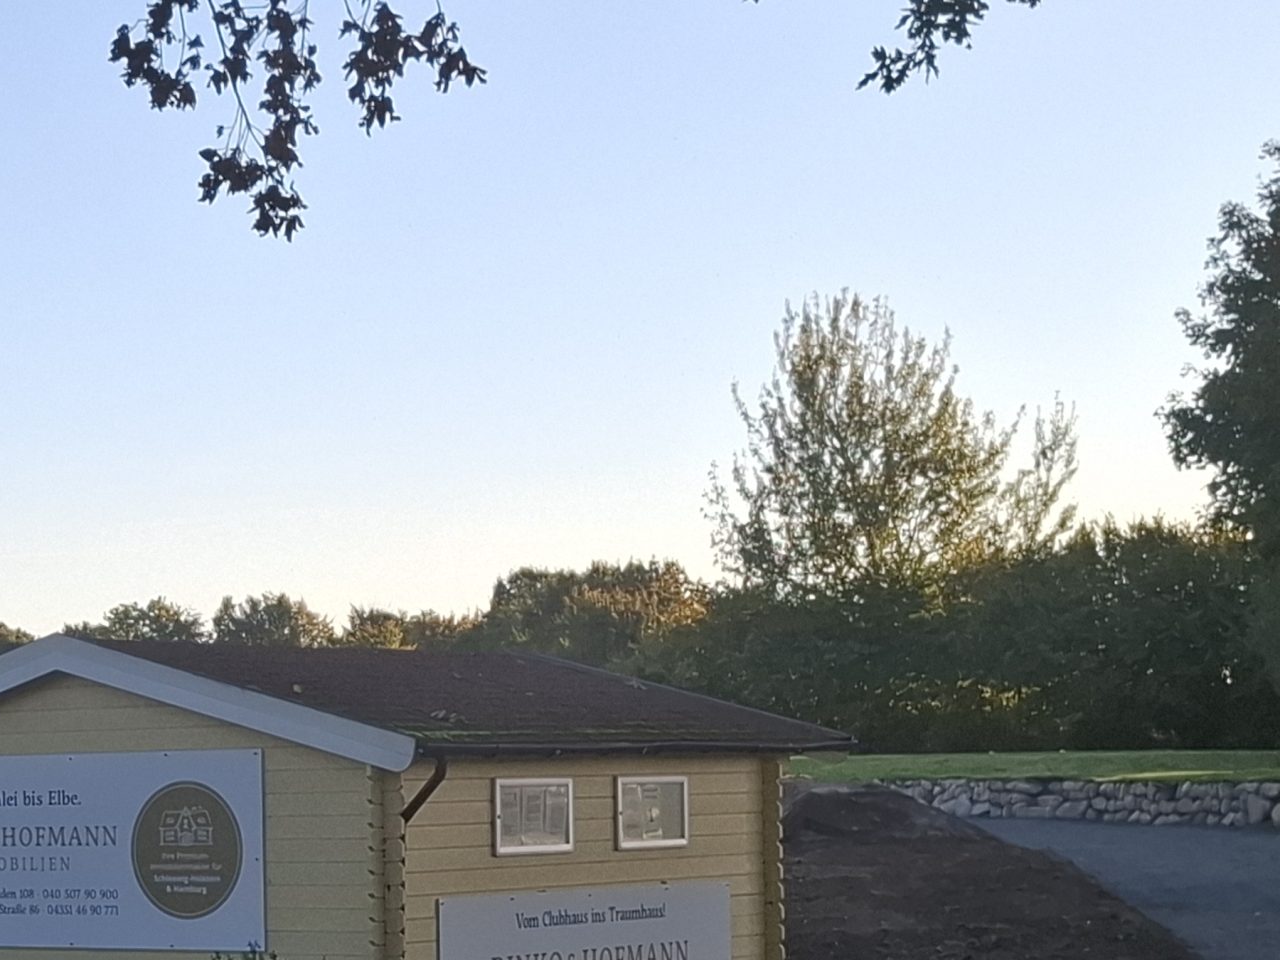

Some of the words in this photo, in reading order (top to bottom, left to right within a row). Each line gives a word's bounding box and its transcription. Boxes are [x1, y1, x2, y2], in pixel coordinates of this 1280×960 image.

[23, 790, 43, 806] bis
[47, 789, 82, 806] Elbe.
[42, 888, 62, 899] 040
[64, 888, 81, 899] 507
[83, 888, 97, 900] 90
[99, 888, 119, 900] 900
[89, 904, 103, 916] 90
[516, 912, 539, 929] Vom
[542, 908, 589, 928] Clubhaus
[591, 907, 606, 924] ins
[608, 902, 666, 922] Traumhaus!
